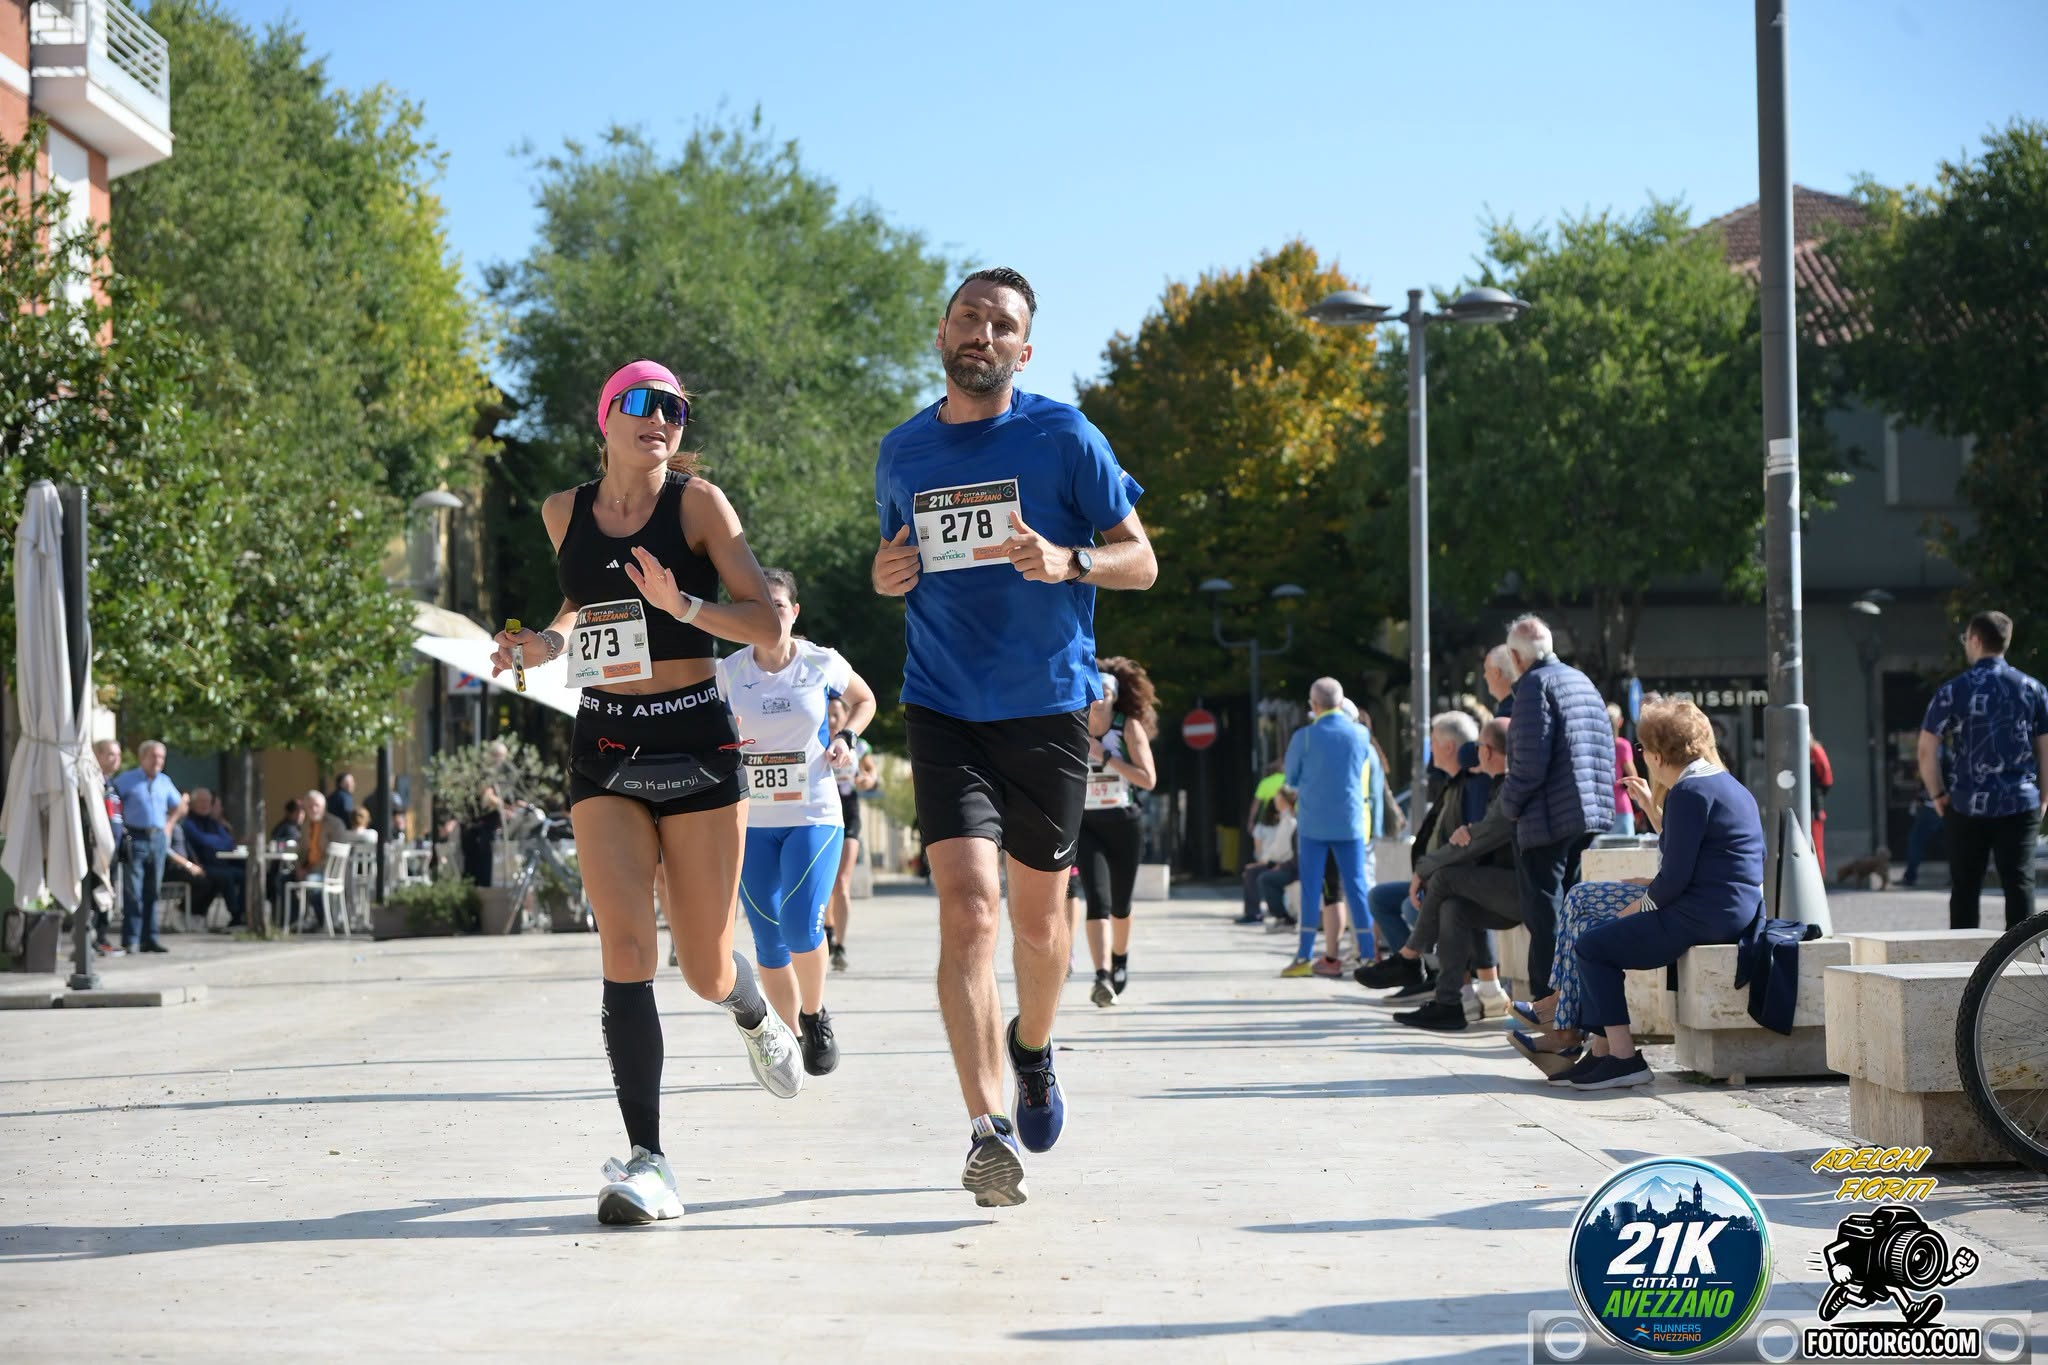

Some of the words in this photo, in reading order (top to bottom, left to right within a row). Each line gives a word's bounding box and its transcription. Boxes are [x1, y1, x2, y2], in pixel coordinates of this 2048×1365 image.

[928, 493, 955, 509] 21K
[940, 509, 993, 544] 278
[580, 627, 620, 661] 273
[632, 686, 718, 717] ARMOUR
[748, 755, 764, 765] 21K
[645, 775, 699, 790] Kalenji
[754, 768, 788, 788] 283
